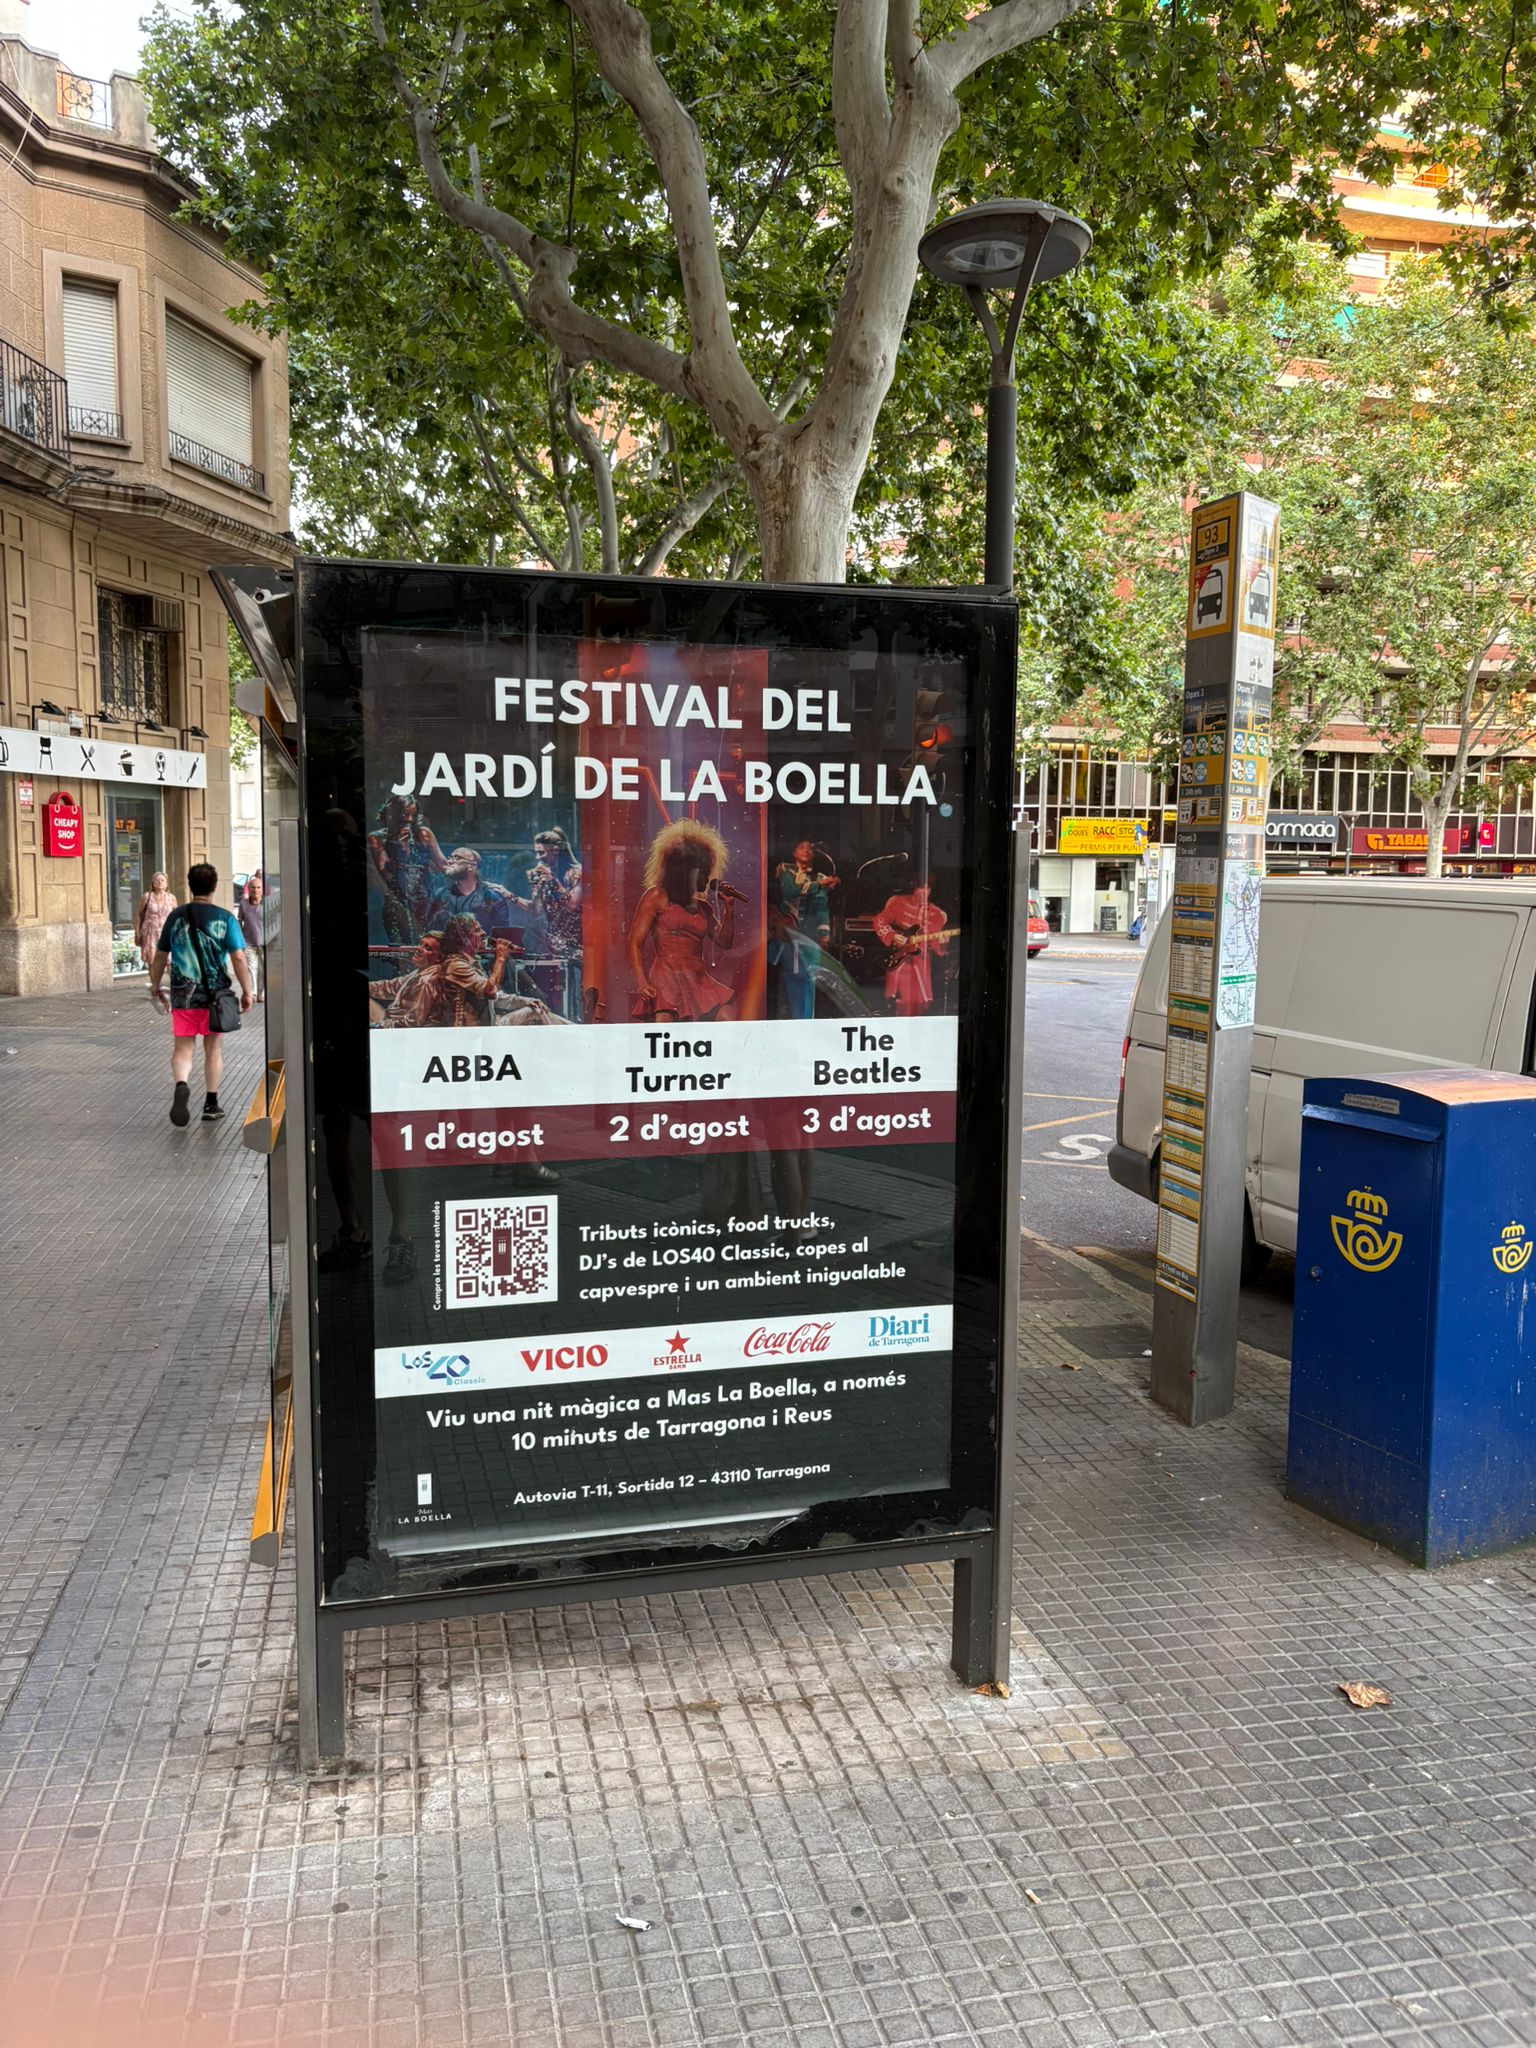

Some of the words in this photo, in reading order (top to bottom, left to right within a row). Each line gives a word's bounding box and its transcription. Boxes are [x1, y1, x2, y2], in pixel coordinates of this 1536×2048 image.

[1204, 525, 1218, 546] 93
[494, 677, 743, 729] FESTIVAL
[762, 687, 852, 732] DEL
[390, 741, 556, 801] JARDÍ
[574, 756, 639, 801] DE
[660, 758, 728, 802] LA
[745, 760, 938, 806] BOELLA
[53, 817, 79, 828] CHEAPY
[57, 829, 76, 840] SHOP
[1093, 826, 1116, 836] RACC
[1118, 827, 1135, 835] STO
[1265, 820, 1336, 838] armacia
[644, 1031, 712, 1059] Tina
[841, 1025, 895, 1052] The
[422, 1054, 523, 1084] ABBA
[625, 1066, 732, 1093] Turner
[813, 1056, 922, 1086] Beatles
[609, 1115, 630, 1142] 2
[802, 1107, 821, 1134] 3
[400, 1124, 413, 1151] 1
[432, 1200, 441, 1238] entrades
[578, 1223, 648, 1242] Tributs
[653, 1219, 722, 1238] icònics,
[726, 1214, 769, 1233] food
[773, 1211, 836, 1230] trucks,
[433, 1239, 441, 1262] teves
[622, 1250, 647, 1268] de
[652, 1246, 716, 1266] LOS40
[720, 1242, 790, 1262] Classic,
[795, 1243, 847, 1260] copes
[851, 1236, 869, 1253] al
[432, 1264, 441, 1276] les
[579, 1282, 679, 1303] capvespre
[684, 1278, 691, 1293] i
[696, 1279, 720, 1291] un
[724, 1270, 801, 1289] ambient
[806, 1261, 907, 1286] inigualable
[433, 1277, 443, 1311] Compra
[867, 1312, 930, 1338] Diari
[743, 1321, 836, 1357] Coca-Cola
[868, 1338, 881, 1347] de
[881, 1336, 930, 1347] Tarragona
[520, 1344, 608, 1372] VICIO
[653, 1353, 702, 1366] ESTRELLA
[453, 1376, 487, 1386] Classic
[426, 1408, 466, 1428] Viu
[473, 1409, 516, 1425] una
[523, 1401, 553, 1420] nit
[560, 1394, 640, 1419] màgica
[646, 1396, 661, 1409] a
[667, 1388, 712, 1407] Mas
[717, 1385, 743, 1403] La
[749, 1377, 817, 1400] Boella,
[823, 1380, 837, 1393] a
[842, 1369, 907, 1391] només
[511, 1431, 536, 1451] 10
[623, 1421, 651, 1441] de
[656, 1415, 766, 1437] Tarragona
[772, 1408, 778, 1426] i
[784, 1406, 832, 1425] Reus
[513, 1487, 577, 1505] Autovia
[581, 1483, 613, 1500] T-11,
[617, 1477, 675, 1495] Sortida
[678, 1474, 695, 1488] 12
[710, 1468, 751, 1485] 43110
[754, 1463, 831, 1480] Tarragona
[397, 1517, 410, 1525] LA
[414, 1512, 453, 1523] BOELLA
